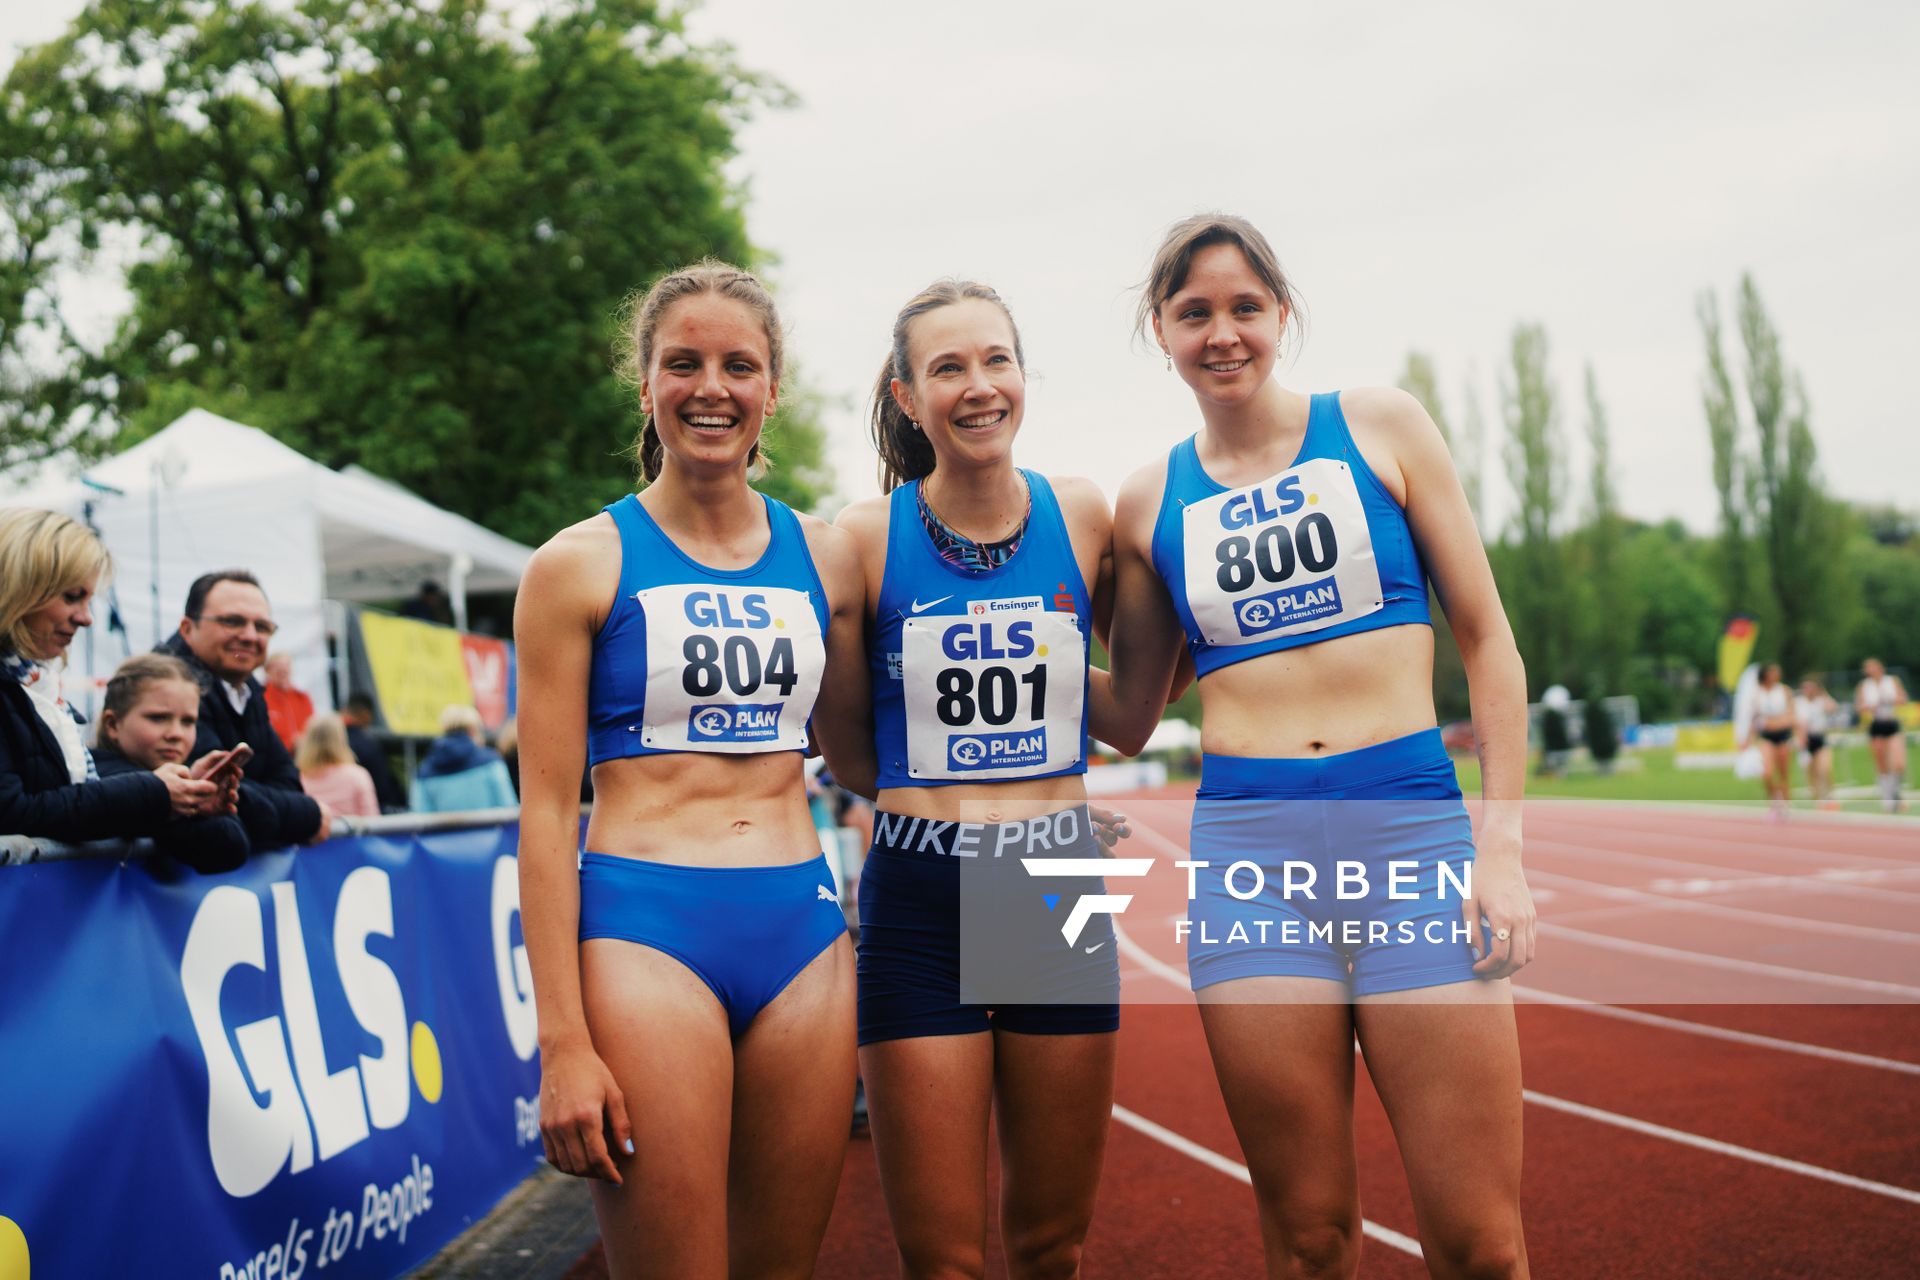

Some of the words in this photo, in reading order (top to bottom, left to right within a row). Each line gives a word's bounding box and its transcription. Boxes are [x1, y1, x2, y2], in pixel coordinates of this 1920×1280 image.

[1219, 475, 1320, 531] GLS.
[1215, 512, 1338, 593] 800
[683, 591, 785, 629] GLS.
[990, 600, 1040, 611] Ensinger
[1277, 585, 1335, 614] PLAN
[1281, 604, 1338, 622] INTERNATIONAL
[942, 621, 1048, 661] GLS.
[682, 634, 798, 697] 804
[936, 663, 1047, 726] 801
[735, 711, 778, 728] PLAN
[735, 729, 776, 737] INTERNATIONAL
[990, 735, 1043, 755] PLAN
[991, 754, 1043, 764] INTERNATIONAL
[874, 812, 985, 858] NIKE
[994, 809, 1078, 858] PRO
[181, 866, 443, 1198] GLS.
[220, 1218, 314, 1280] cels
[316, 1207, 354, 1269] to
[355, 1153, 434, 1250] People
